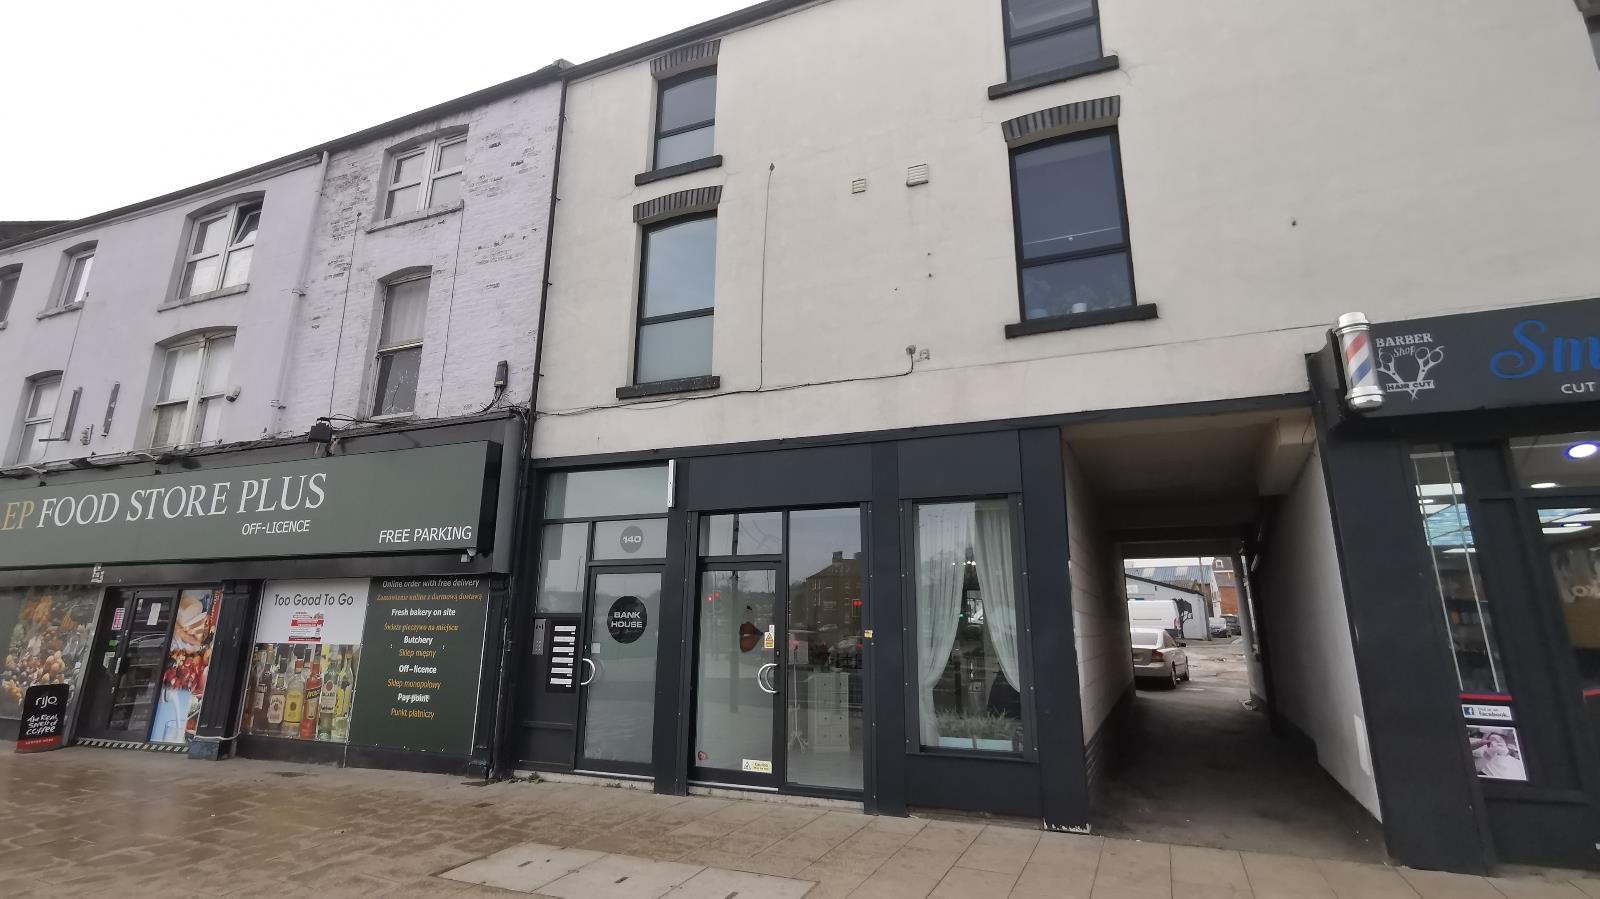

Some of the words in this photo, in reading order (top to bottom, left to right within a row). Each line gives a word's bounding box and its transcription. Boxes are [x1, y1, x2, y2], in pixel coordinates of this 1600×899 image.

[1376, 333, 1433, 347] BARBER
[1387, 383, 1409, 391] HAIR
[1412, 381, 1432, 389] CUT
[1560, 381, 1596, 394] CUT
[0, 500, 35, 531] EP
[36, 492, 120, 529] FOOD
[126, 481, 231, 522] STORE
[236, 472, 327, 514] PLUS
[241, 519, 311, 536] OFF-LICENCE
[378, 528, 410, 544] FREE
[413, 525, 472, 542] PARKING
[622, 535, 642, 544] 140
[382, 580, 403, 588] Online
[404, 580, 421, 588] order
[422, 579, 437, 587] with
[437, 579, 452, 588] free
[452, 578, 480, 588] delivery
[274, 594, 291, 606] Too
[293, 593, 322, 606] Good
[324, 593, 335, 606] To
[338, 593, 354, 606] Go
[391, 608, 409, 616] Fresh
[409, 608, 432, 618] bakery
[442, 608, 456, 616] site
[613, 611, 641, 619] BANK
[611, 620, 643, 628] HOUSE
[403, 635, 434, 646] Butchery
[399, 648, 415, 658] Sklep
[398, 664, 437, 674] Off-licence
[387, 678, 403, 689] Sklep
[403, 679, 442, 690] monopolowy
[390, 707, 408, 716] Punkt
